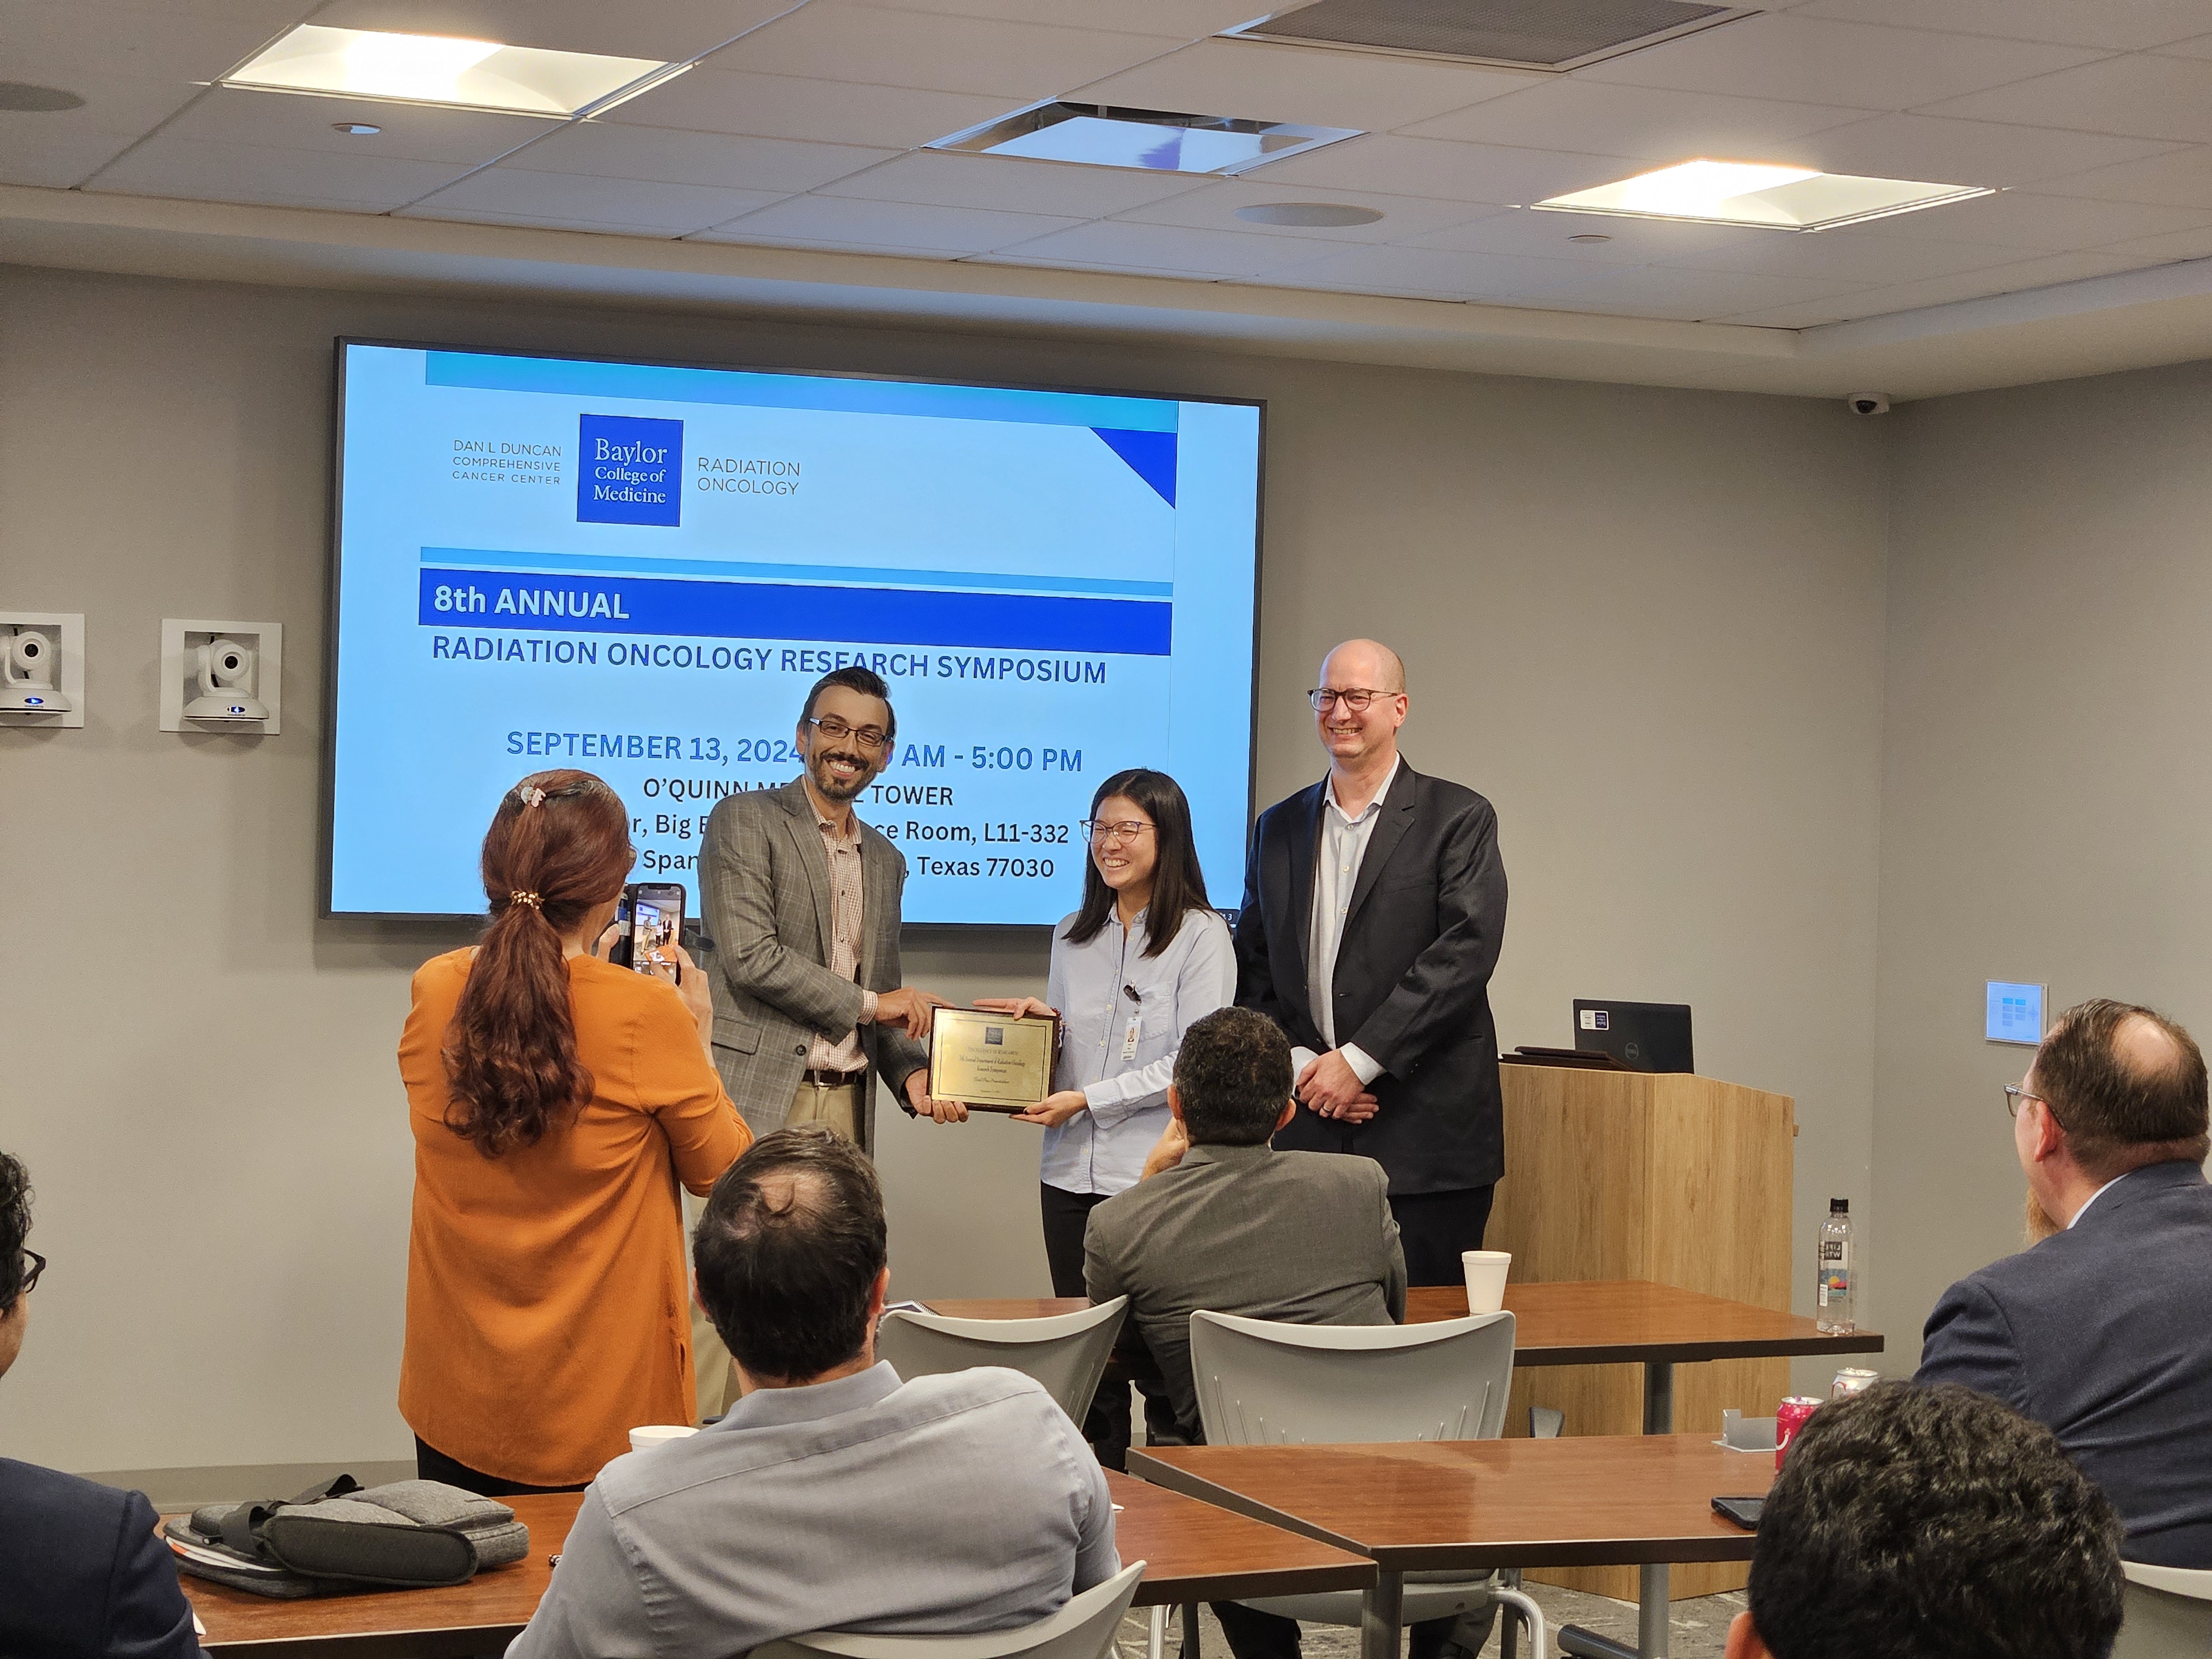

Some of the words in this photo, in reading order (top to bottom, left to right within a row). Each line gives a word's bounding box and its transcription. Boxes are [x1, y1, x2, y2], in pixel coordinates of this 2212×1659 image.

[453, 440, 484, 452] DAN
[489, 442, 496, 453] L
[501, 442, 561, 457] DUNCAN
[594, 438, 667, 466] Baylor
[453, 456, 560, 472] COMPREHENSIVE
[698, 457, 800, 477] RADIATION
[452, 471, 505, 482] CANCER
[511, 474, 560, 485] CENTER
[595, 466, 648, 486] College
[649, 469, 667, 483] of
[698, 477, 799, 495] ONCOLOGY
[593, 484, 666, 503] Medicine
[434, 585, 486, 613] 8th
[494, 588, 629, 619] ANNUAL
[433, 635, 597, 665] RADIATION
[608, 643, 773, 671] ONCOLOGY
[781, 649, 928, 677] RESEARCH
[937, 655, 1106, 684] SYMPOSIUM
[507, 731, 681, 760] SEPTEMBER
[690, 737, 728, 766] 13,
[901, 744, 945, 768] AM
[972, 746, 1032, 770] 5:00
[1042, 748, 1082, 772] PM
[870, 785, 953, 806] TOWER
[656, 814, 691, 839] Big
[906, 821, 976, 846] Room,
[984, 822, 1069, 843] L11-332
[917, 856, 980, 877] Texas
[986, 858, 1054, 878] 77030
